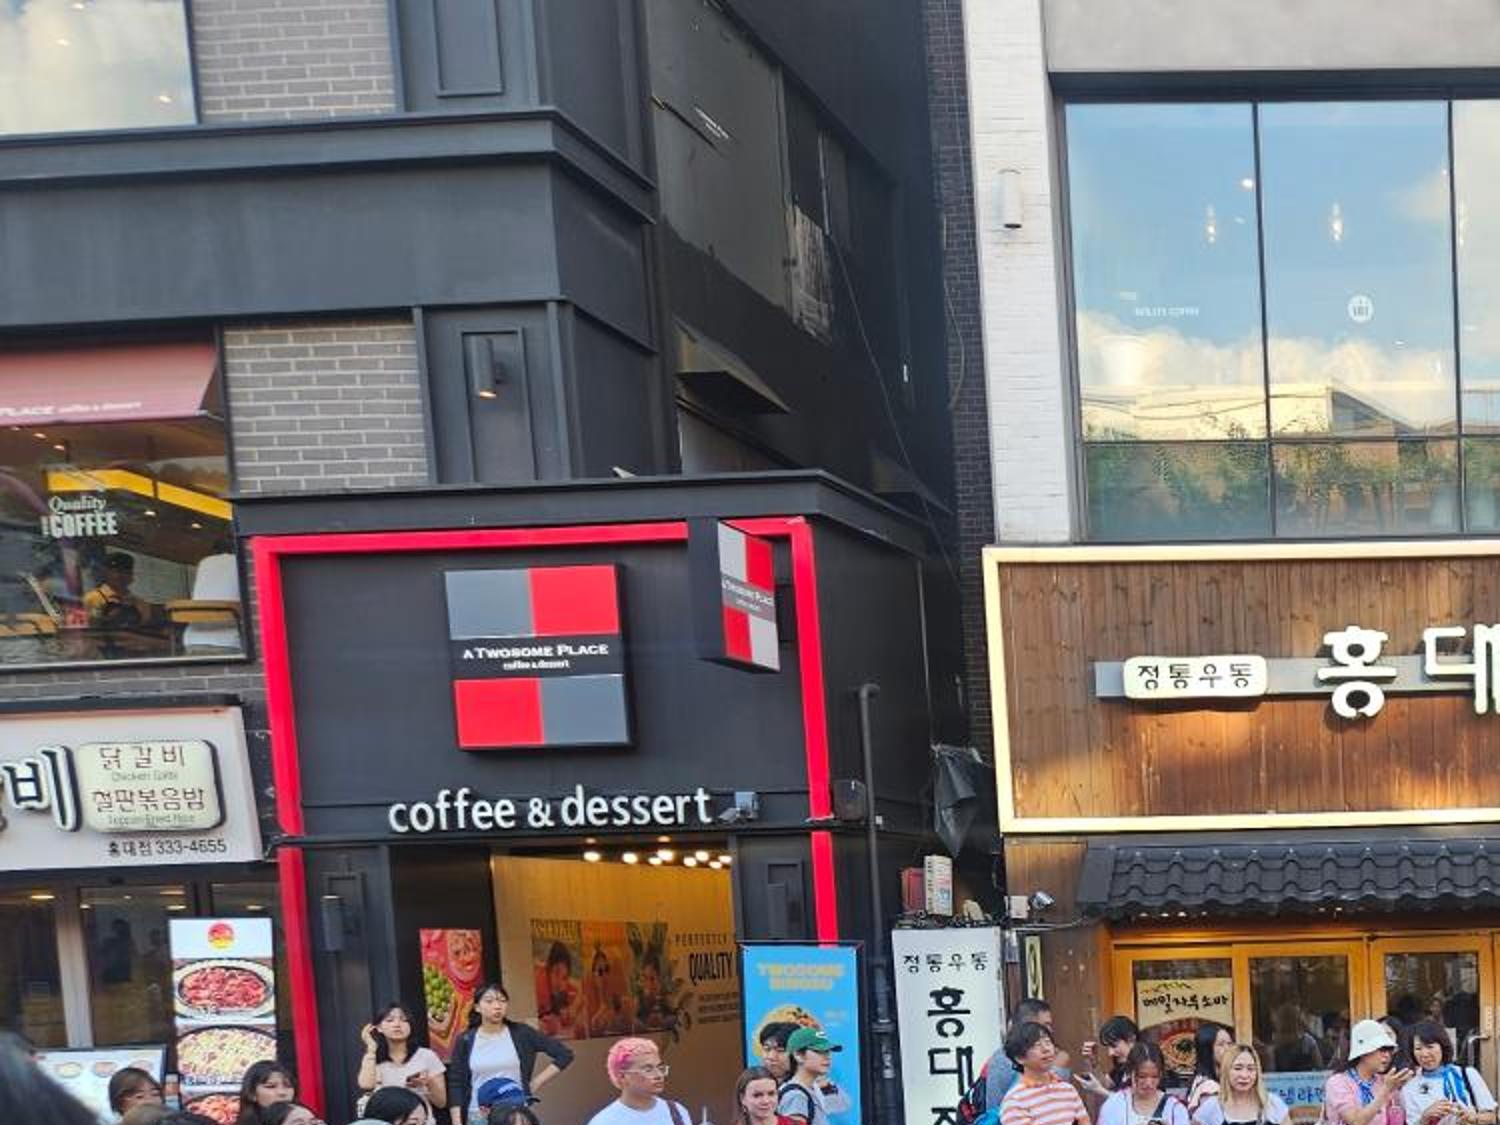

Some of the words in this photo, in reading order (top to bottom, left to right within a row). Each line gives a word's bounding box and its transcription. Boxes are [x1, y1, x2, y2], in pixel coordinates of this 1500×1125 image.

[49, 495, 107, 515] Quality
[51, 511, 119, 538] COFFEE
[463, 648, 474, 660] A
[474, 645, 554, 660] TWOSOME
[557, 643, 609, 656] PLACE
[100, 745, 184, 770] 닭갈비
[0, 748, 70, 828] 비
[92, 787, 205, 813] 철판볶음밥
[388, 787, 516, 833] coffee
[527, 797, 556, 829] &
[561, 784, 713, 827] dessert
[109, 841, 153, 858] 홍대점
[156, 839, 227, 856] 333-4655
[689, 952, 733, 986] QUALITY
